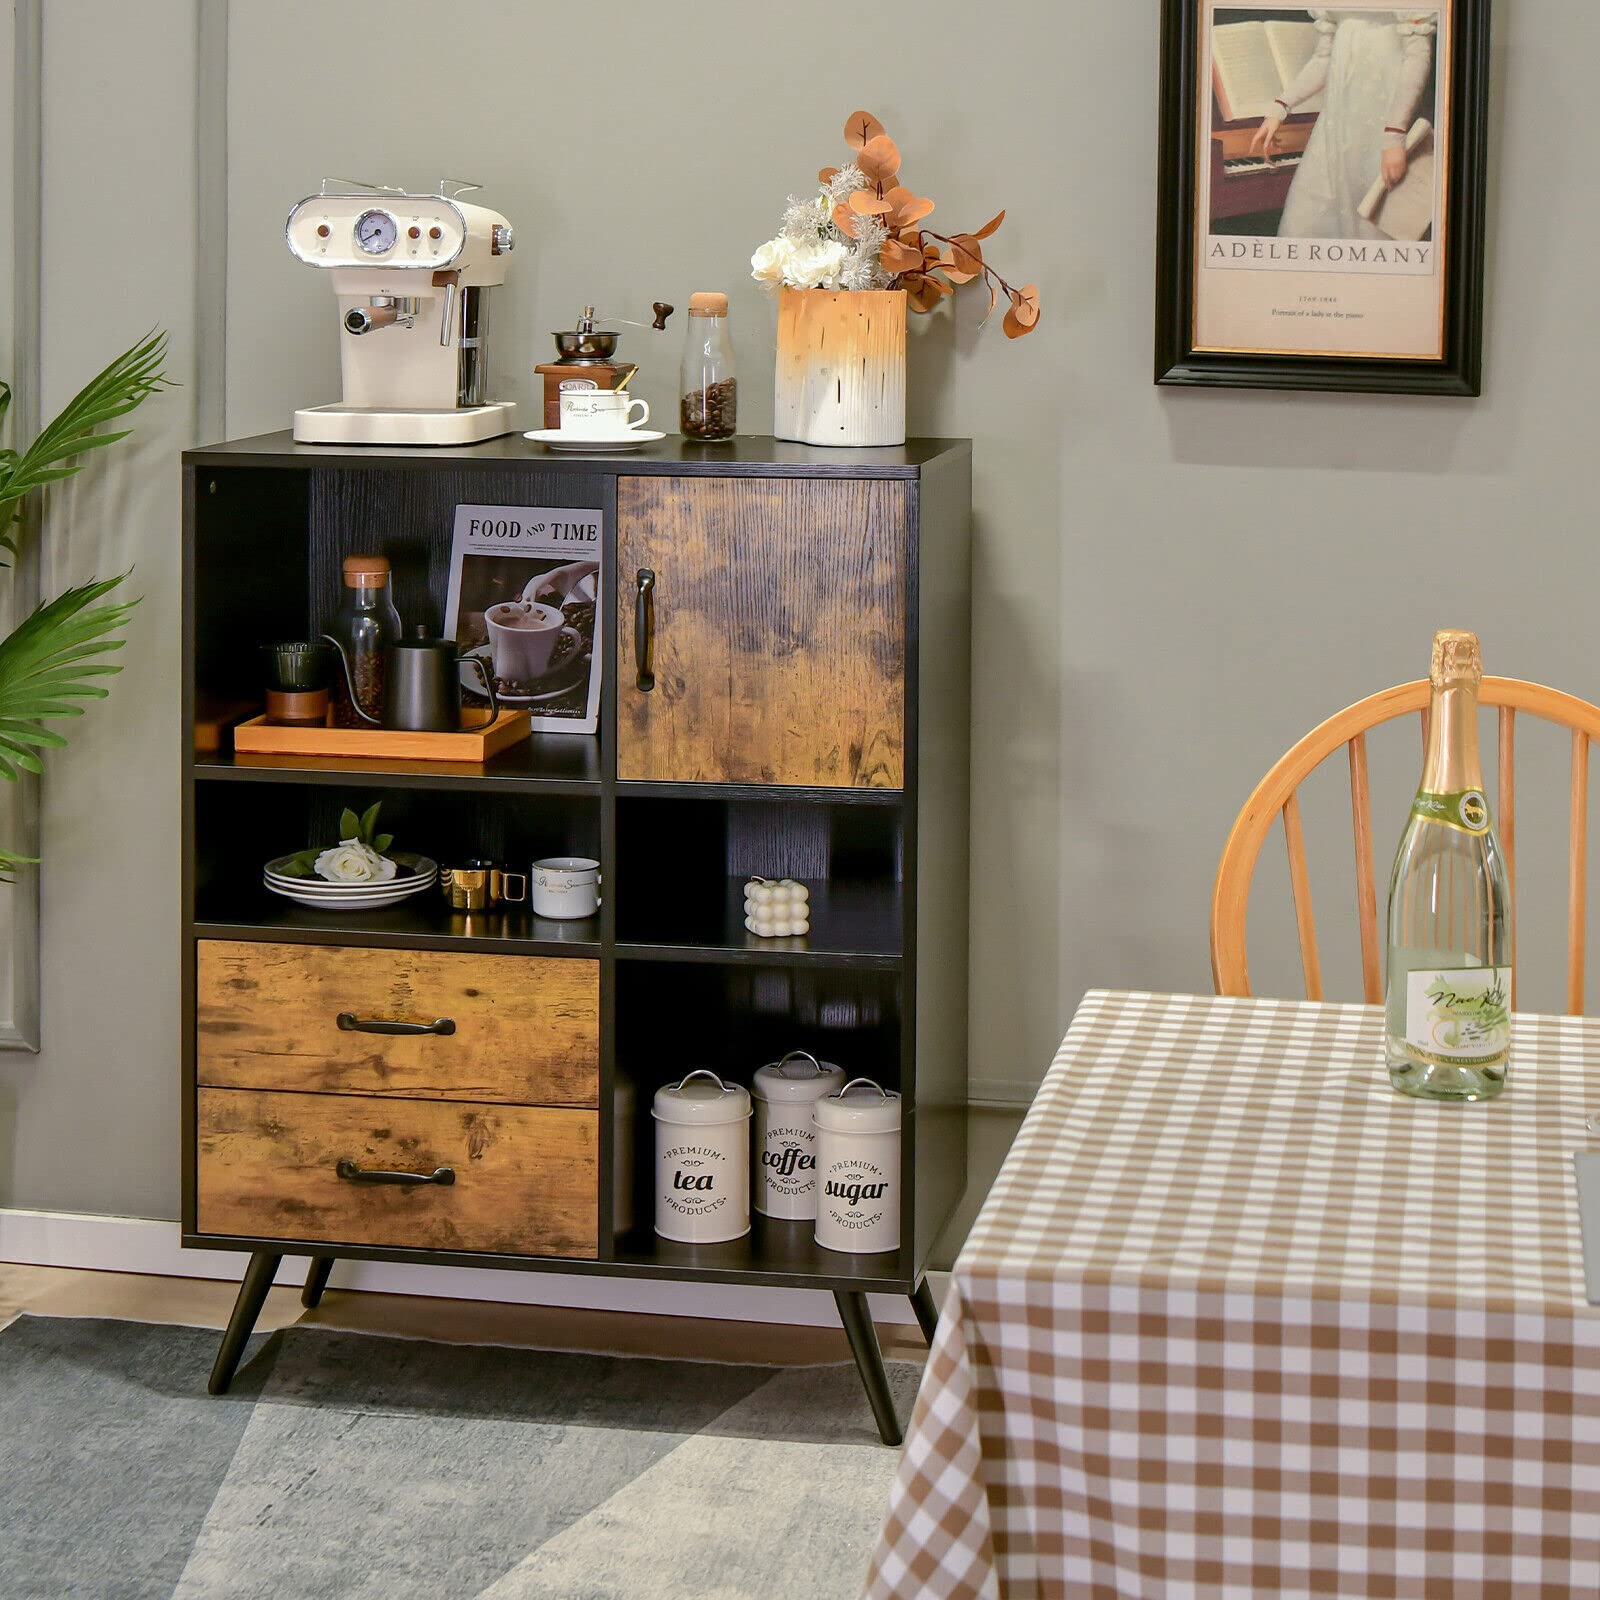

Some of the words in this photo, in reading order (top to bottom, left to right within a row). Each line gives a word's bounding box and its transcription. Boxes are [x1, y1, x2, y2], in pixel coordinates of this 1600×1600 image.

[1211, 240, 1298, 260] ADÈLE
[1308, 245, 1430, 263] ROMANY
[1311, 310, 1325, 319] lady
[1333, 311, 1344, 319] the
[469, 519, 521, 538] FOOD
[526, 522, 546, 538] AND
[550, 523, 598, 541] TIME
[767, 1128, 816, 1142] PREMIUM
[666, 1146, 721, 1160] PREMIUM
[831, 1160, 879, 1174] PREMIUM
[673, 1170, 714, 1191] tea
[824, 1180, 889, 1206] sugar
[666, 1196, 725, 1215] PRODUCTS
[831, 1211, 881, 1229] PRODUCTS
